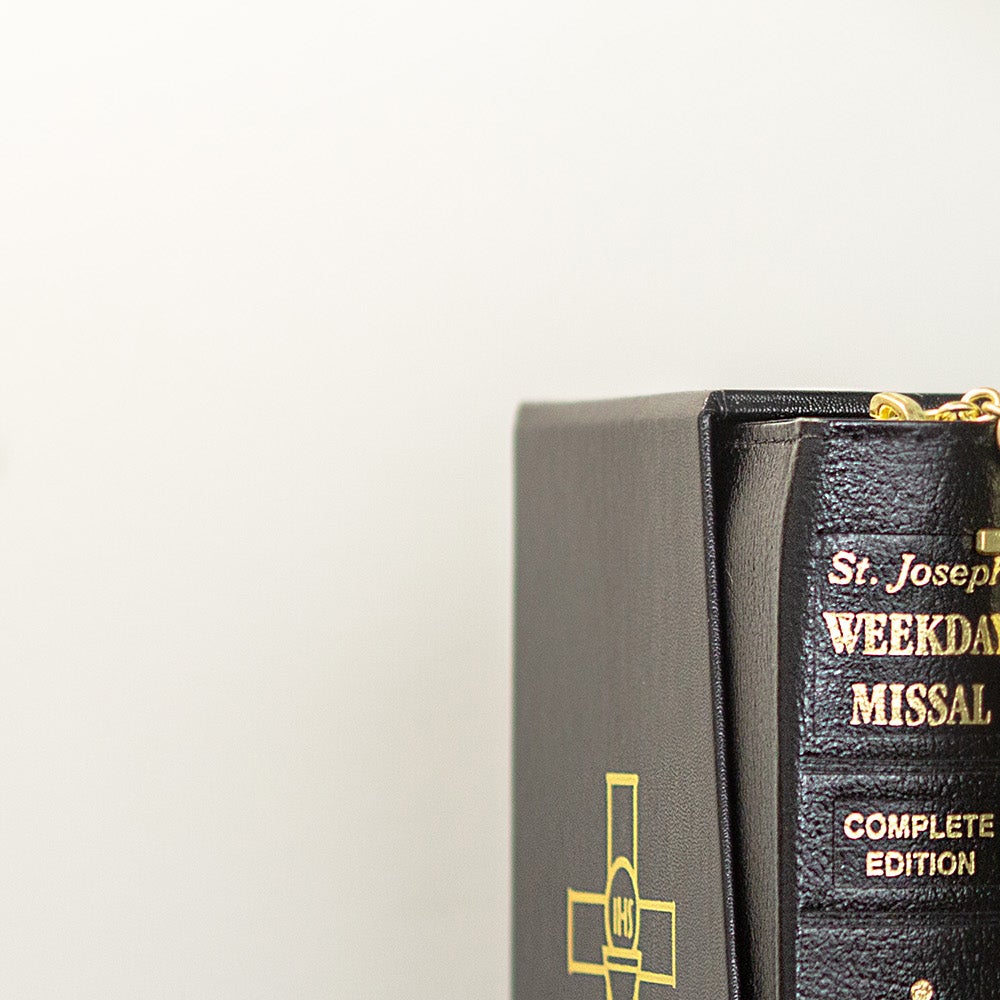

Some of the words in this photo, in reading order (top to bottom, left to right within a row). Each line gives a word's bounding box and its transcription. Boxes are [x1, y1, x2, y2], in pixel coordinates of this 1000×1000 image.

[828, 550, 878, 585] St.
[850, 682, 992, 726] MISSAL
[843, 812, 995, 840] COMPLETE
[865, 850, 976, 877] EDITION
